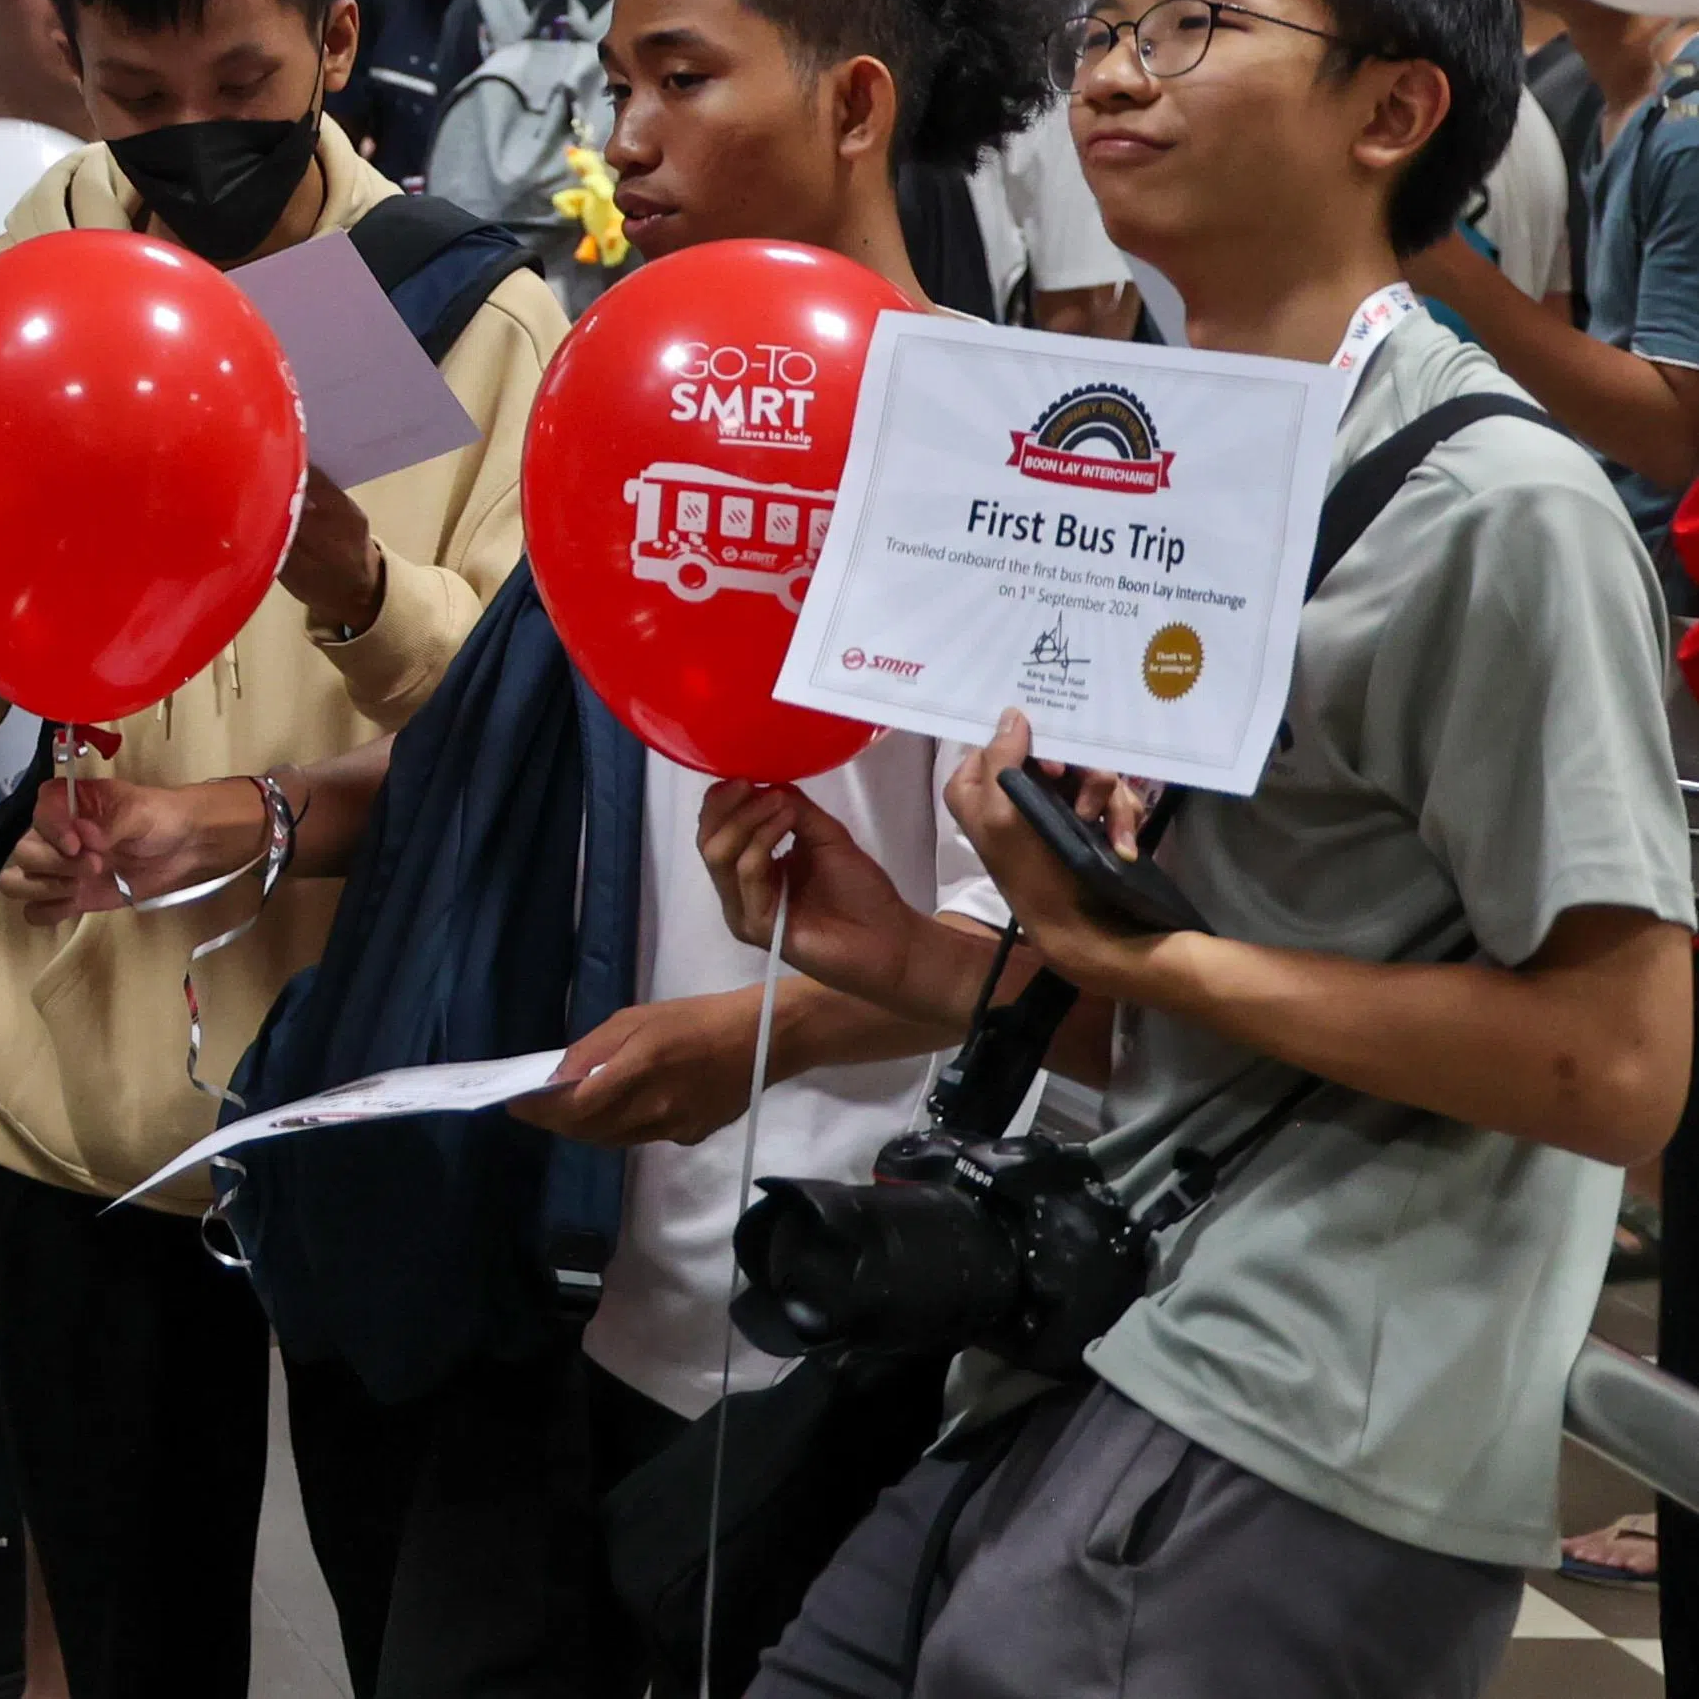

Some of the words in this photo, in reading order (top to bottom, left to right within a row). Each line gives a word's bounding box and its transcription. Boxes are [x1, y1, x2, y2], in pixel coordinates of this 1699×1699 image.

[678, 342, 818, 386] GO-TO
[670, 382, 815, 429] SMRT
[740, 425, 766, 441] love
[769, 428, 782, 442] to
[784, 428, 813, 445] help
[1024, 455, 1057, 474] BOON
[1059, 461, 1082, 477] LAY
[1082, 465, 1155, 487] INTERCHANGE
[967, 498, 1046, 544] First
[1054, 512, 1116, 555] Bus
[1128, 523, 1186, 573] Trip
[885, 536, 947, 561] Travelled
[948, 550, 1007, 572] onboard
[1009, 558, 1031, 575] the
[1033, 561, 1058, 580] first
[1060, 566, 1083, 584] bus
[1085, 570, 1115, 590] from
[1118, 575, 1150, 596] Boon
[1153, 580, 1174, 601] Lay
[998, 584, 1016, 600] on
[1037, 588, 1106, 614] September
[1108, 599, 1140, 618] 2024
[866, 654, 926, 679] SMRT
[955, 1156, 995, 1188] Nikon
